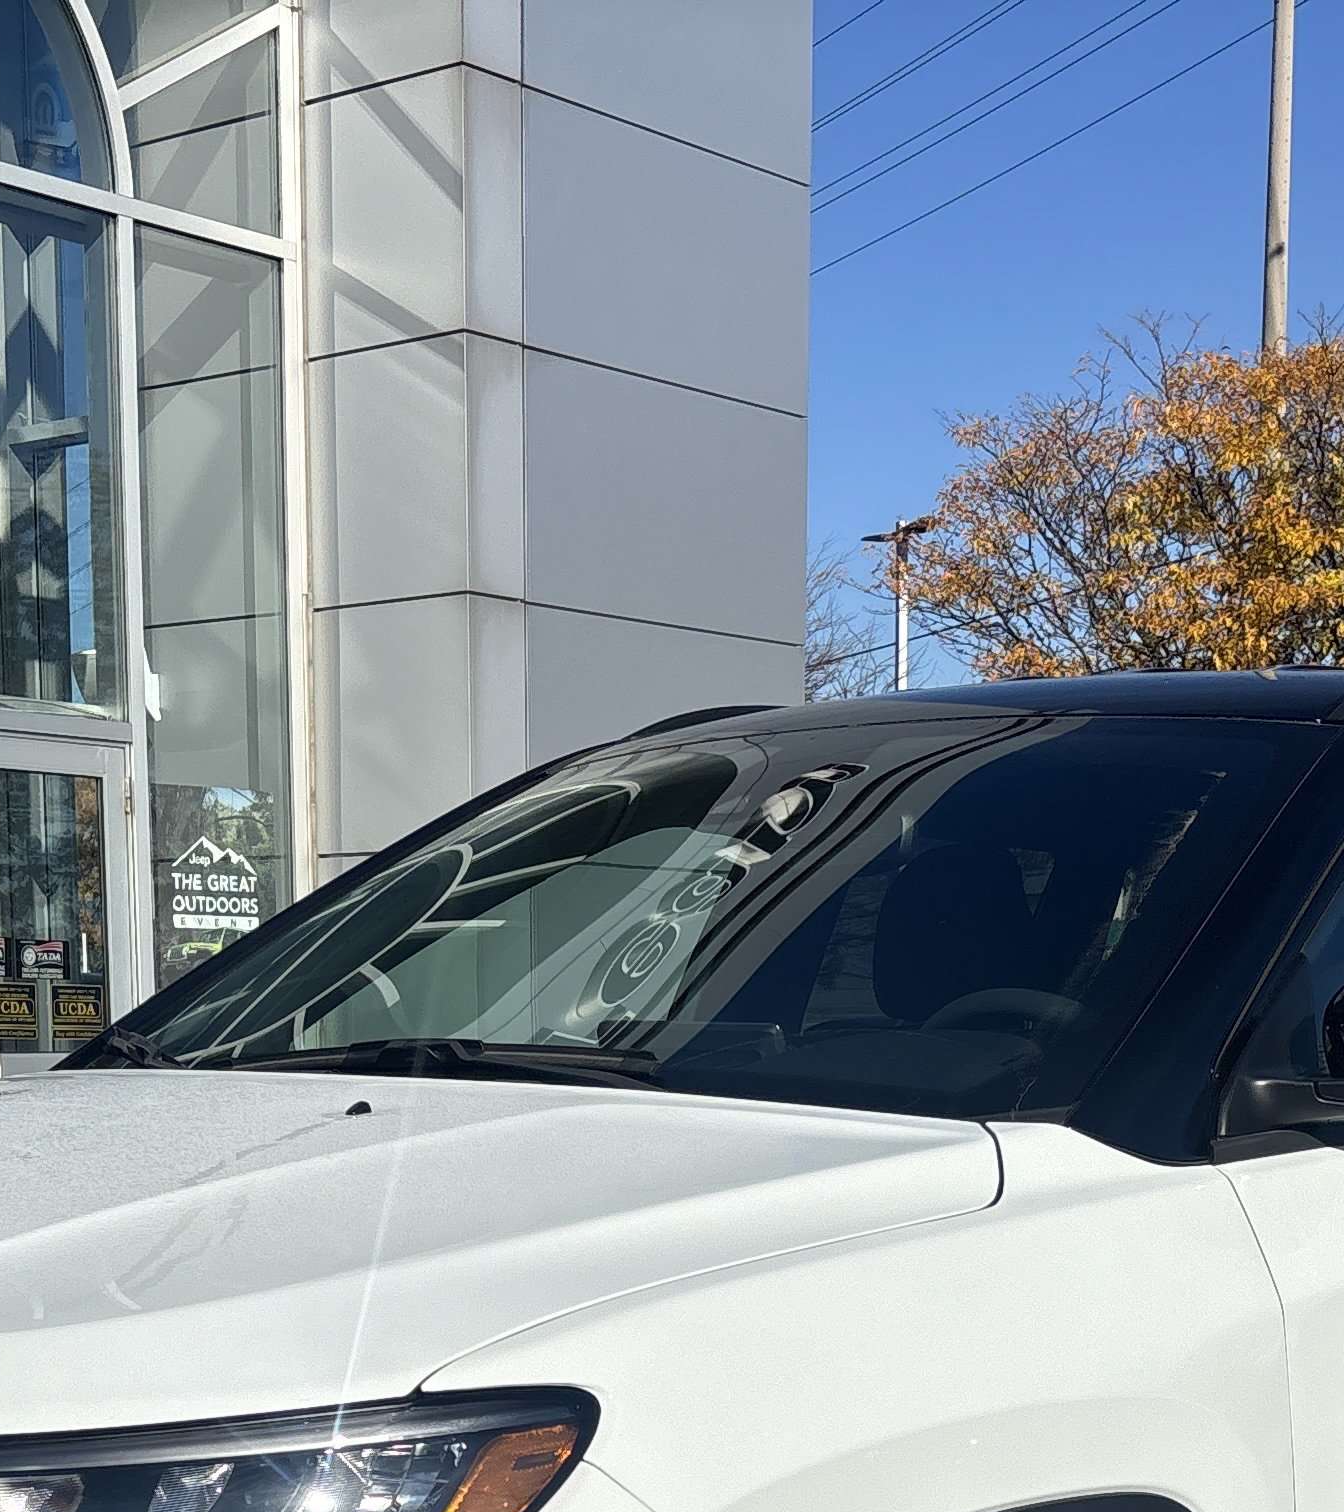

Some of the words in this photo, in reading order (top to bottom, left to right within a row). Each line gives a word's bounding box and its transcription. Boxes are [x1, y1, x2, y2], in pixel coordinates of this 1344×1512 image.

[189, 853, 211, 867] Jeep
[171, 873, 203, 890] THE
[207, 874, 257, 893] GREAT
[172, 895, 259, 914] OUTDOORS
[181, 917, 253, 928] EVENT
[59, 1003, 96, 1016] UCDA
